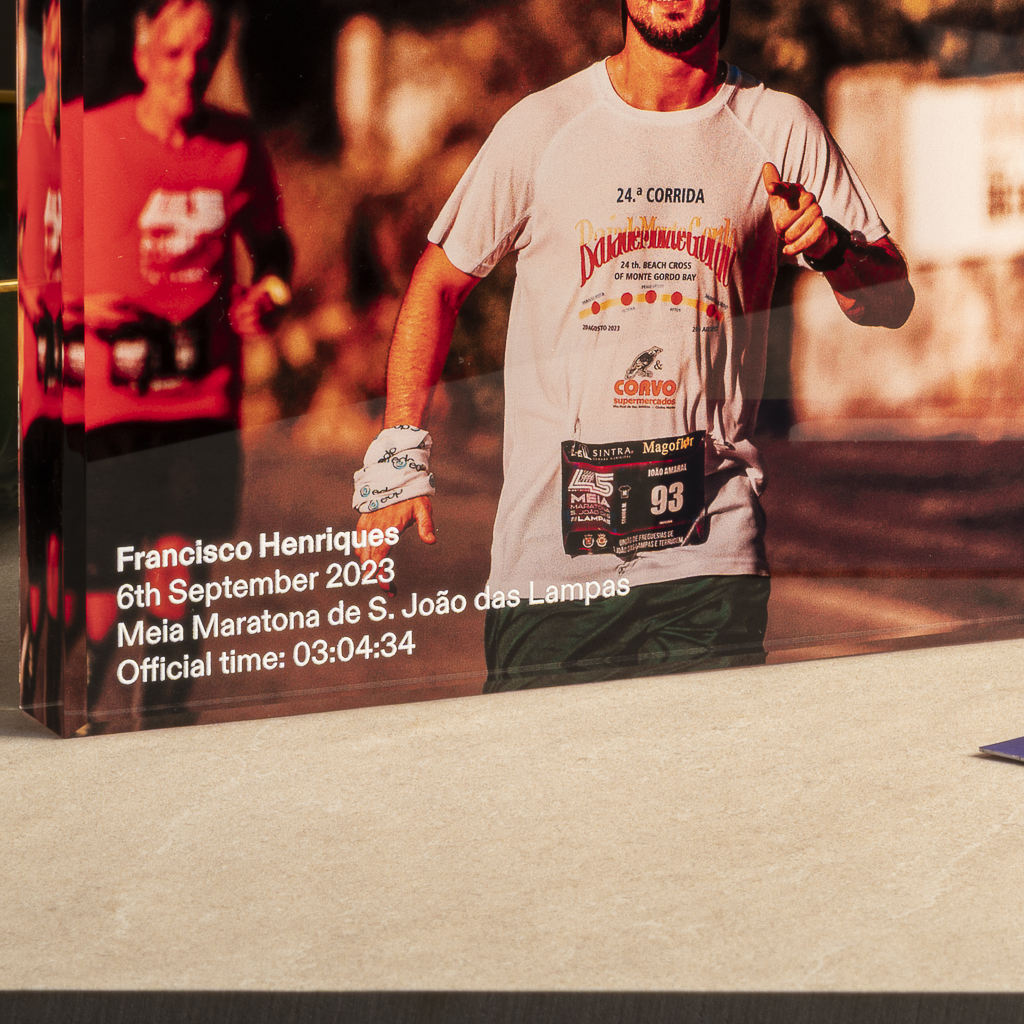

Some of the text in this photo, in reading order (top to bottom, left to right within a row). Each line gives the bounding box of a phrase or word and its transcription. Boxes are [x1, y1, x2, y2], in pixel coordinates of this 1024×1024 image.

[646, 187, 705, 204] CORRIDA
[620, 261, 630, 269] 24
[643, 261, 667, 269] BEACH
[668, 261, 692, 269] CROSS
[614, 272, 697, 282] OF MONTE GORDO BAY
[614, 379, 677, 396] CORVO
[613, 397, 676, 405] supermercados
[592, 447, 631, 457] SINTRA
[642, 437, 694, 455] Magoflor
[571, 493, 611, 508] MEIA
[650, 481, 684, 515] 93
[117, 526, 400, 572] Francisco Henriques
[116, 557, 395, 609] 6th September 2023
[117, 577, 631, 647] Meia Maratona de S. João das Lampas
[117, 630, 416, 685] Official time: 03:04:34
